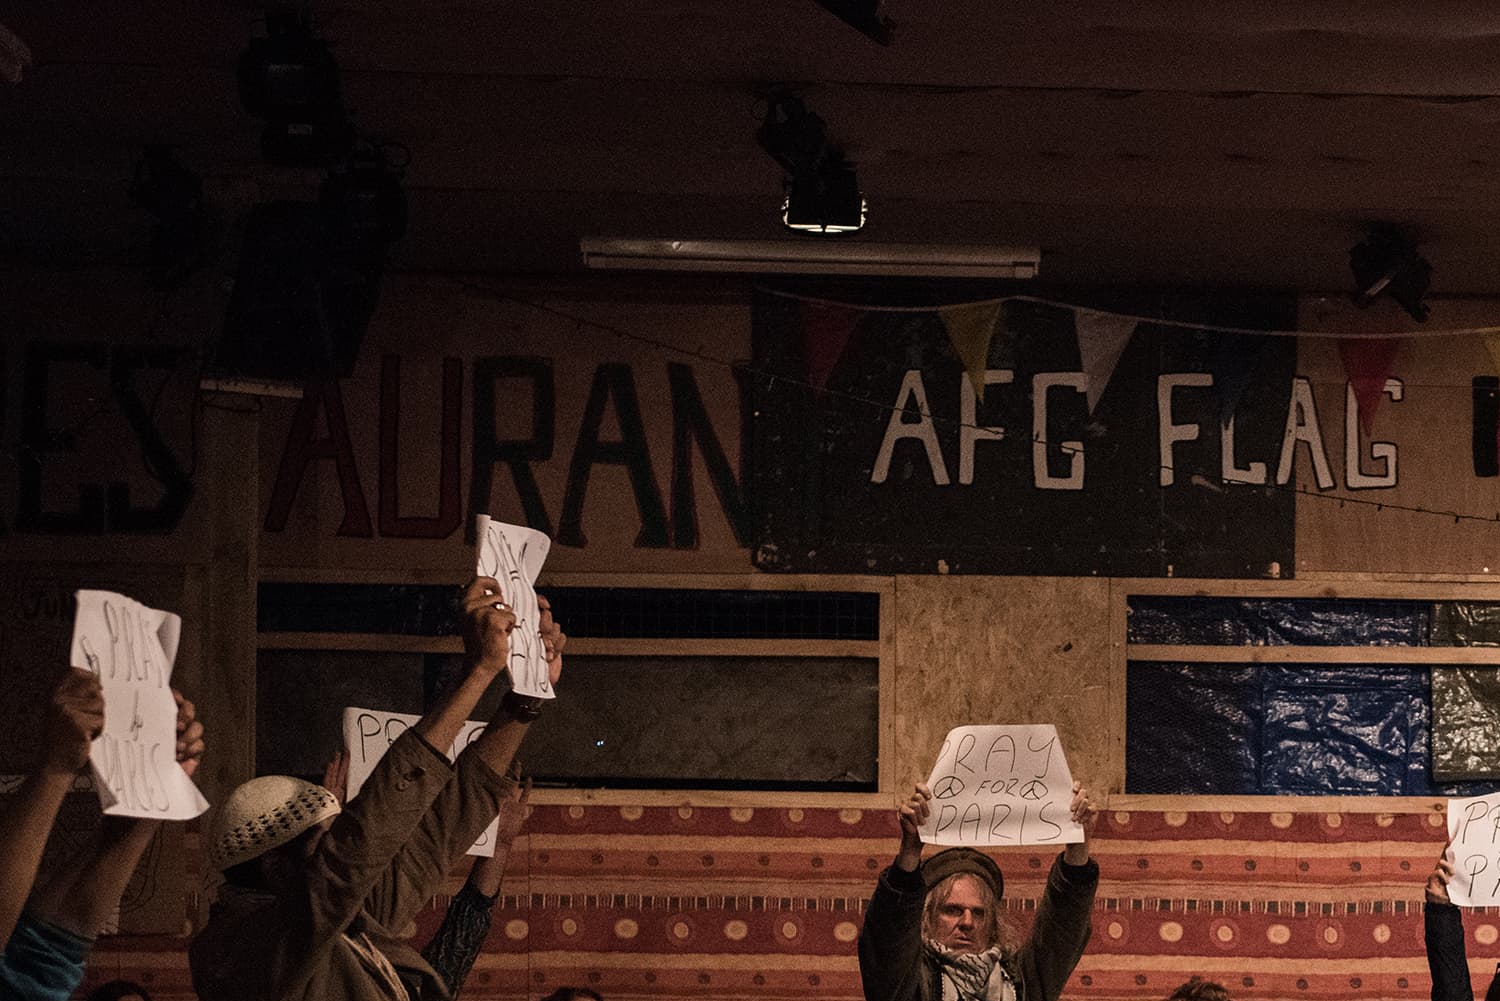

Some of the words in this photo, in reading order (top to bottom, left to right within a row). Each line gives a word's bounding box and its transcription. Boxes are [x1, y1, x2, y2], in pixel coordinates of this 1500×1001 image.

[868, 368, 1088, 490] AFG
[1156, 371, 1405, 490] FLAG
[974, 778, 1019, 797] FOR
[934, 802, 1062, 845] PARIS
